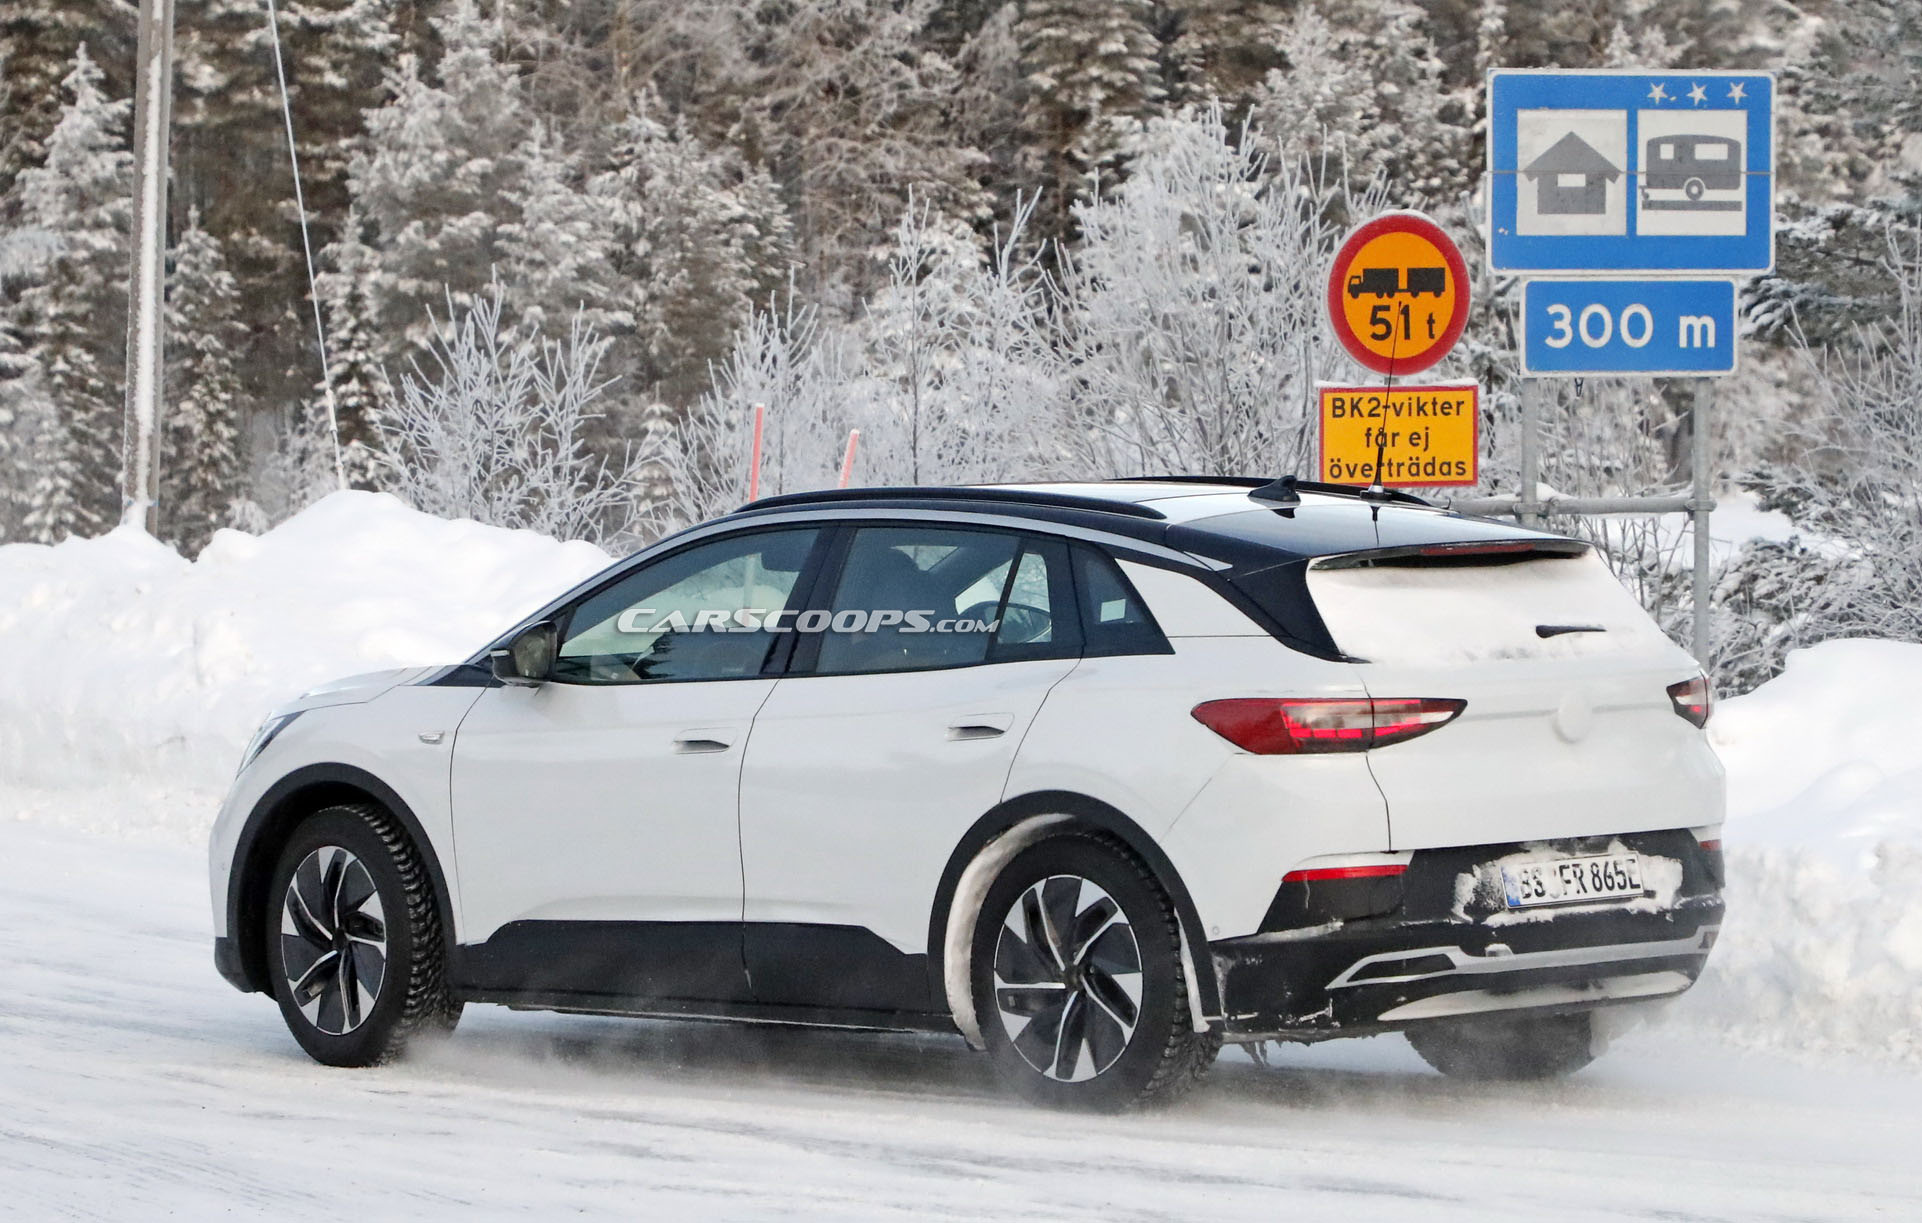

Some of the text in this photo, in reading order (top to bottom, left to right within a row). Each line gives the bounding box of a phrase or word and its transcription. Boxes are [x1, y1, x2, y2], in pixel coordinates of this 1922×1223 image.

[1369, 303, 1436, 341] 51 t
[1545, 303, 1716, 348] 300 m
[1331, 396, 1465, 418] BK2-vikter
[1365, 426, 1429, 452] får ej
[1330, 456, 1466, 479] öveträdas
